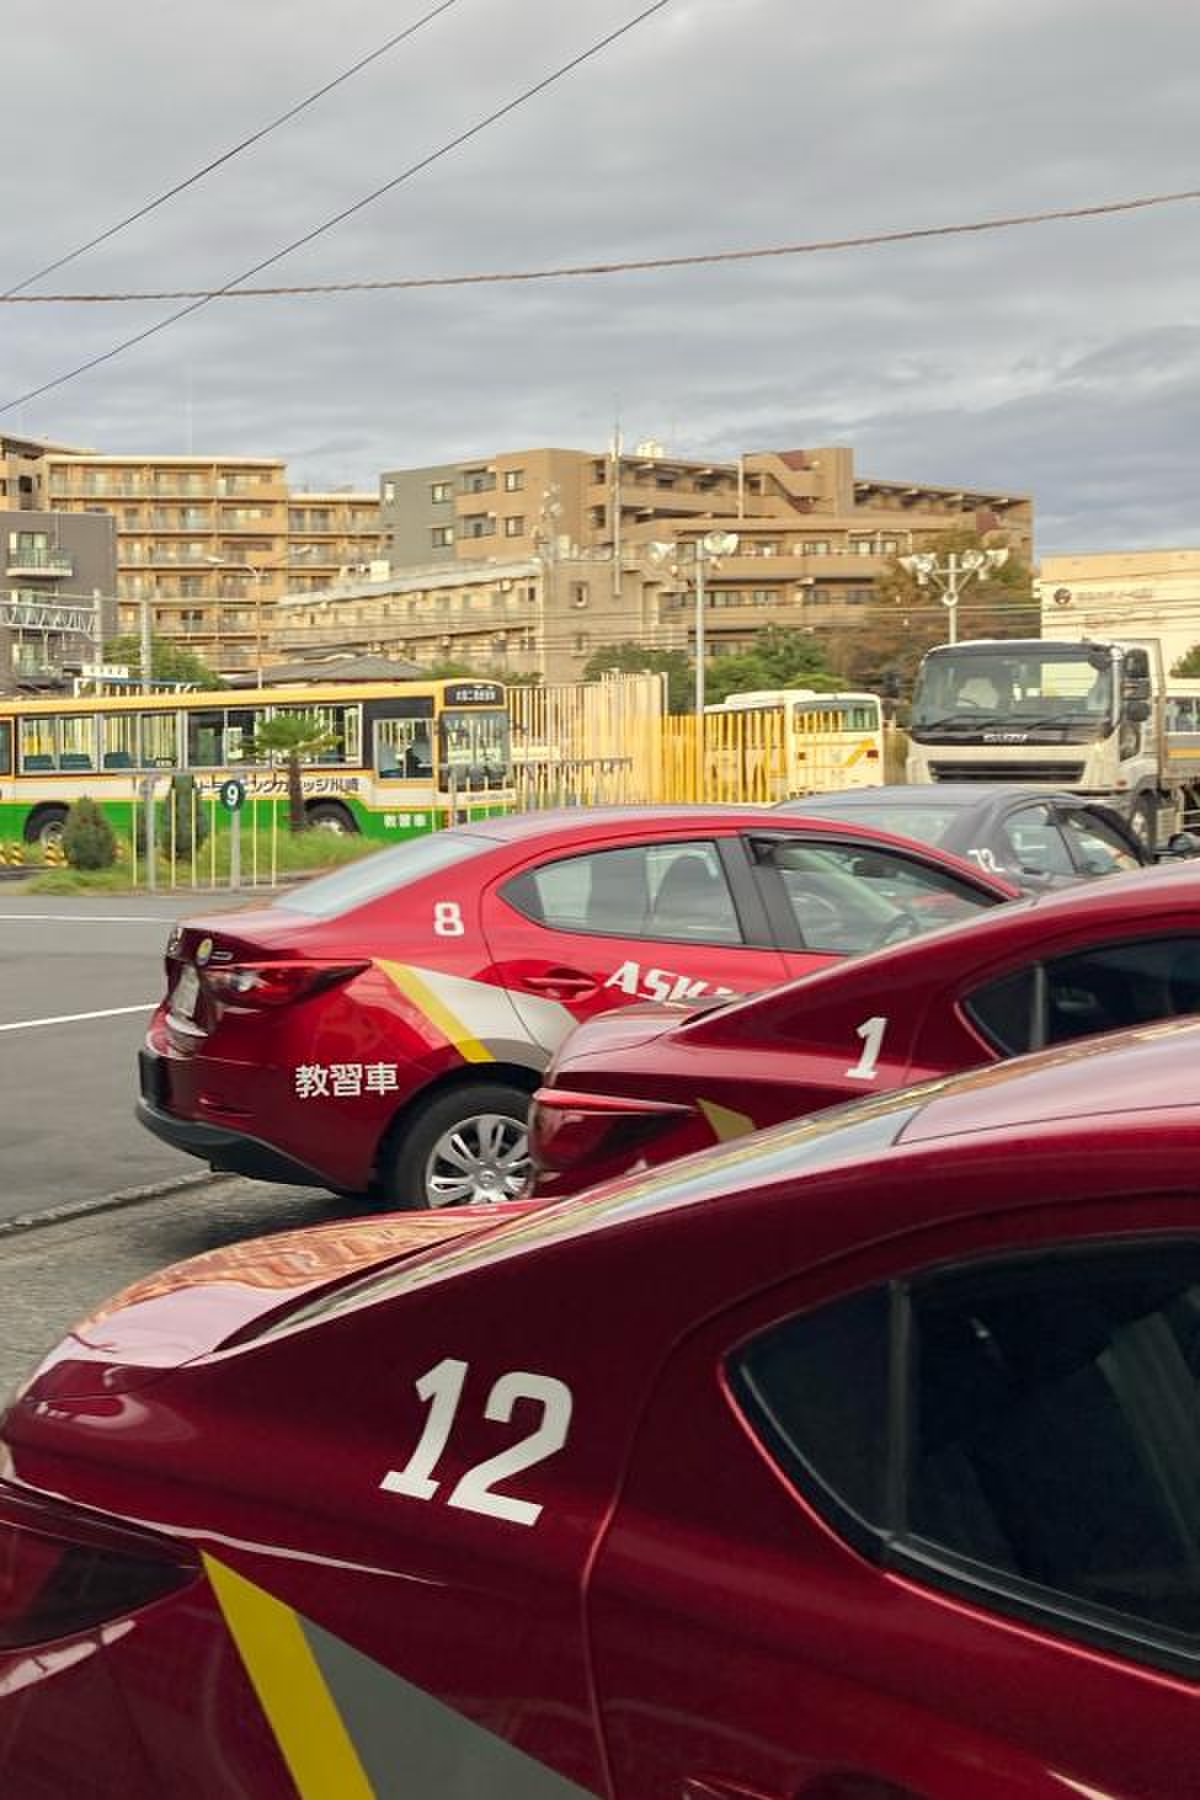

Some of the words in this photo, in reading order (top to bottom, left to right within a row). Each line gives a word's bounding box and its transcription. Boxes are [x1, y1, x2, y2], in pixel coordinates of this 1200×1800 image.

[227, 784, 239, 806] 9
[967, 848, 1006, 873] 72
[433, 901, 465, 936] 8
[604, 960, 743, 1003] ASK
[844, 1016, 888, 1079] 1
[295, 1061, 400, 1099] 教習車
[379, 1357, 574, 1527] 12
